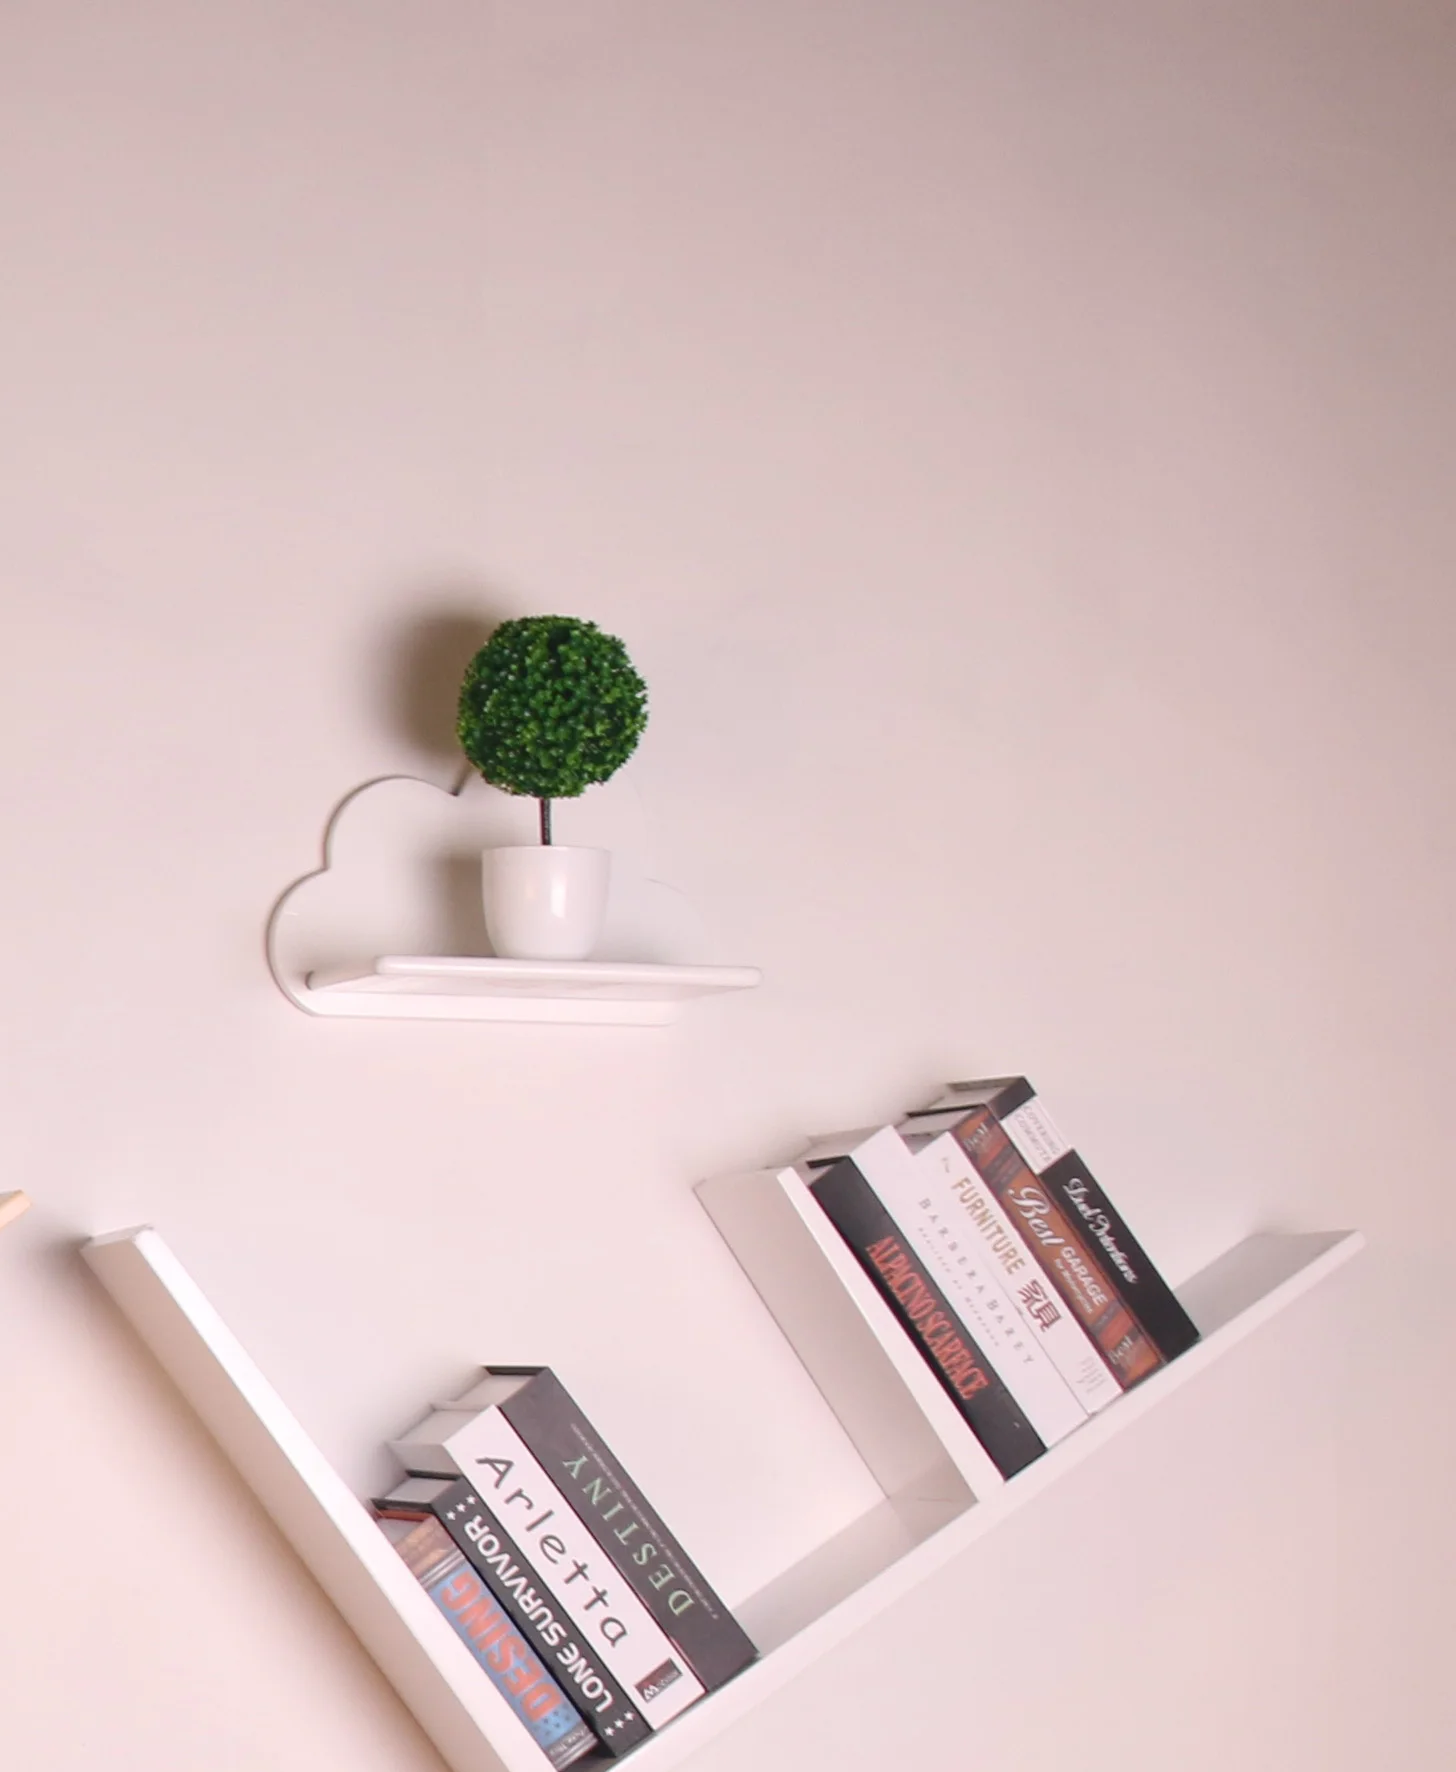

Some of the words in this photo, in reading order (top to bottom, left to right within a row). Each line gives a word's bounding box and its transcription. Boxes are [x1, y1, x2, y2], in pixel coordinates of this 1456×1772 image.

[951, 1177, 1027, 1276] FURNITURE
[1007, 1184, 1066, 1248] Best
[1058, 1244, 1109, 1308] GARAGE
[916, 1312, 988, 1398] SCARFACE
[464, 1515, 568, 1645] SURVIVOR
[476, 1456, 628, 1648] Arletta
[563, 1456, 695, 1616] DESTINY
[441, 1574, 564, 1722] DESING
[556, 1647, 613, 1713] LONE
